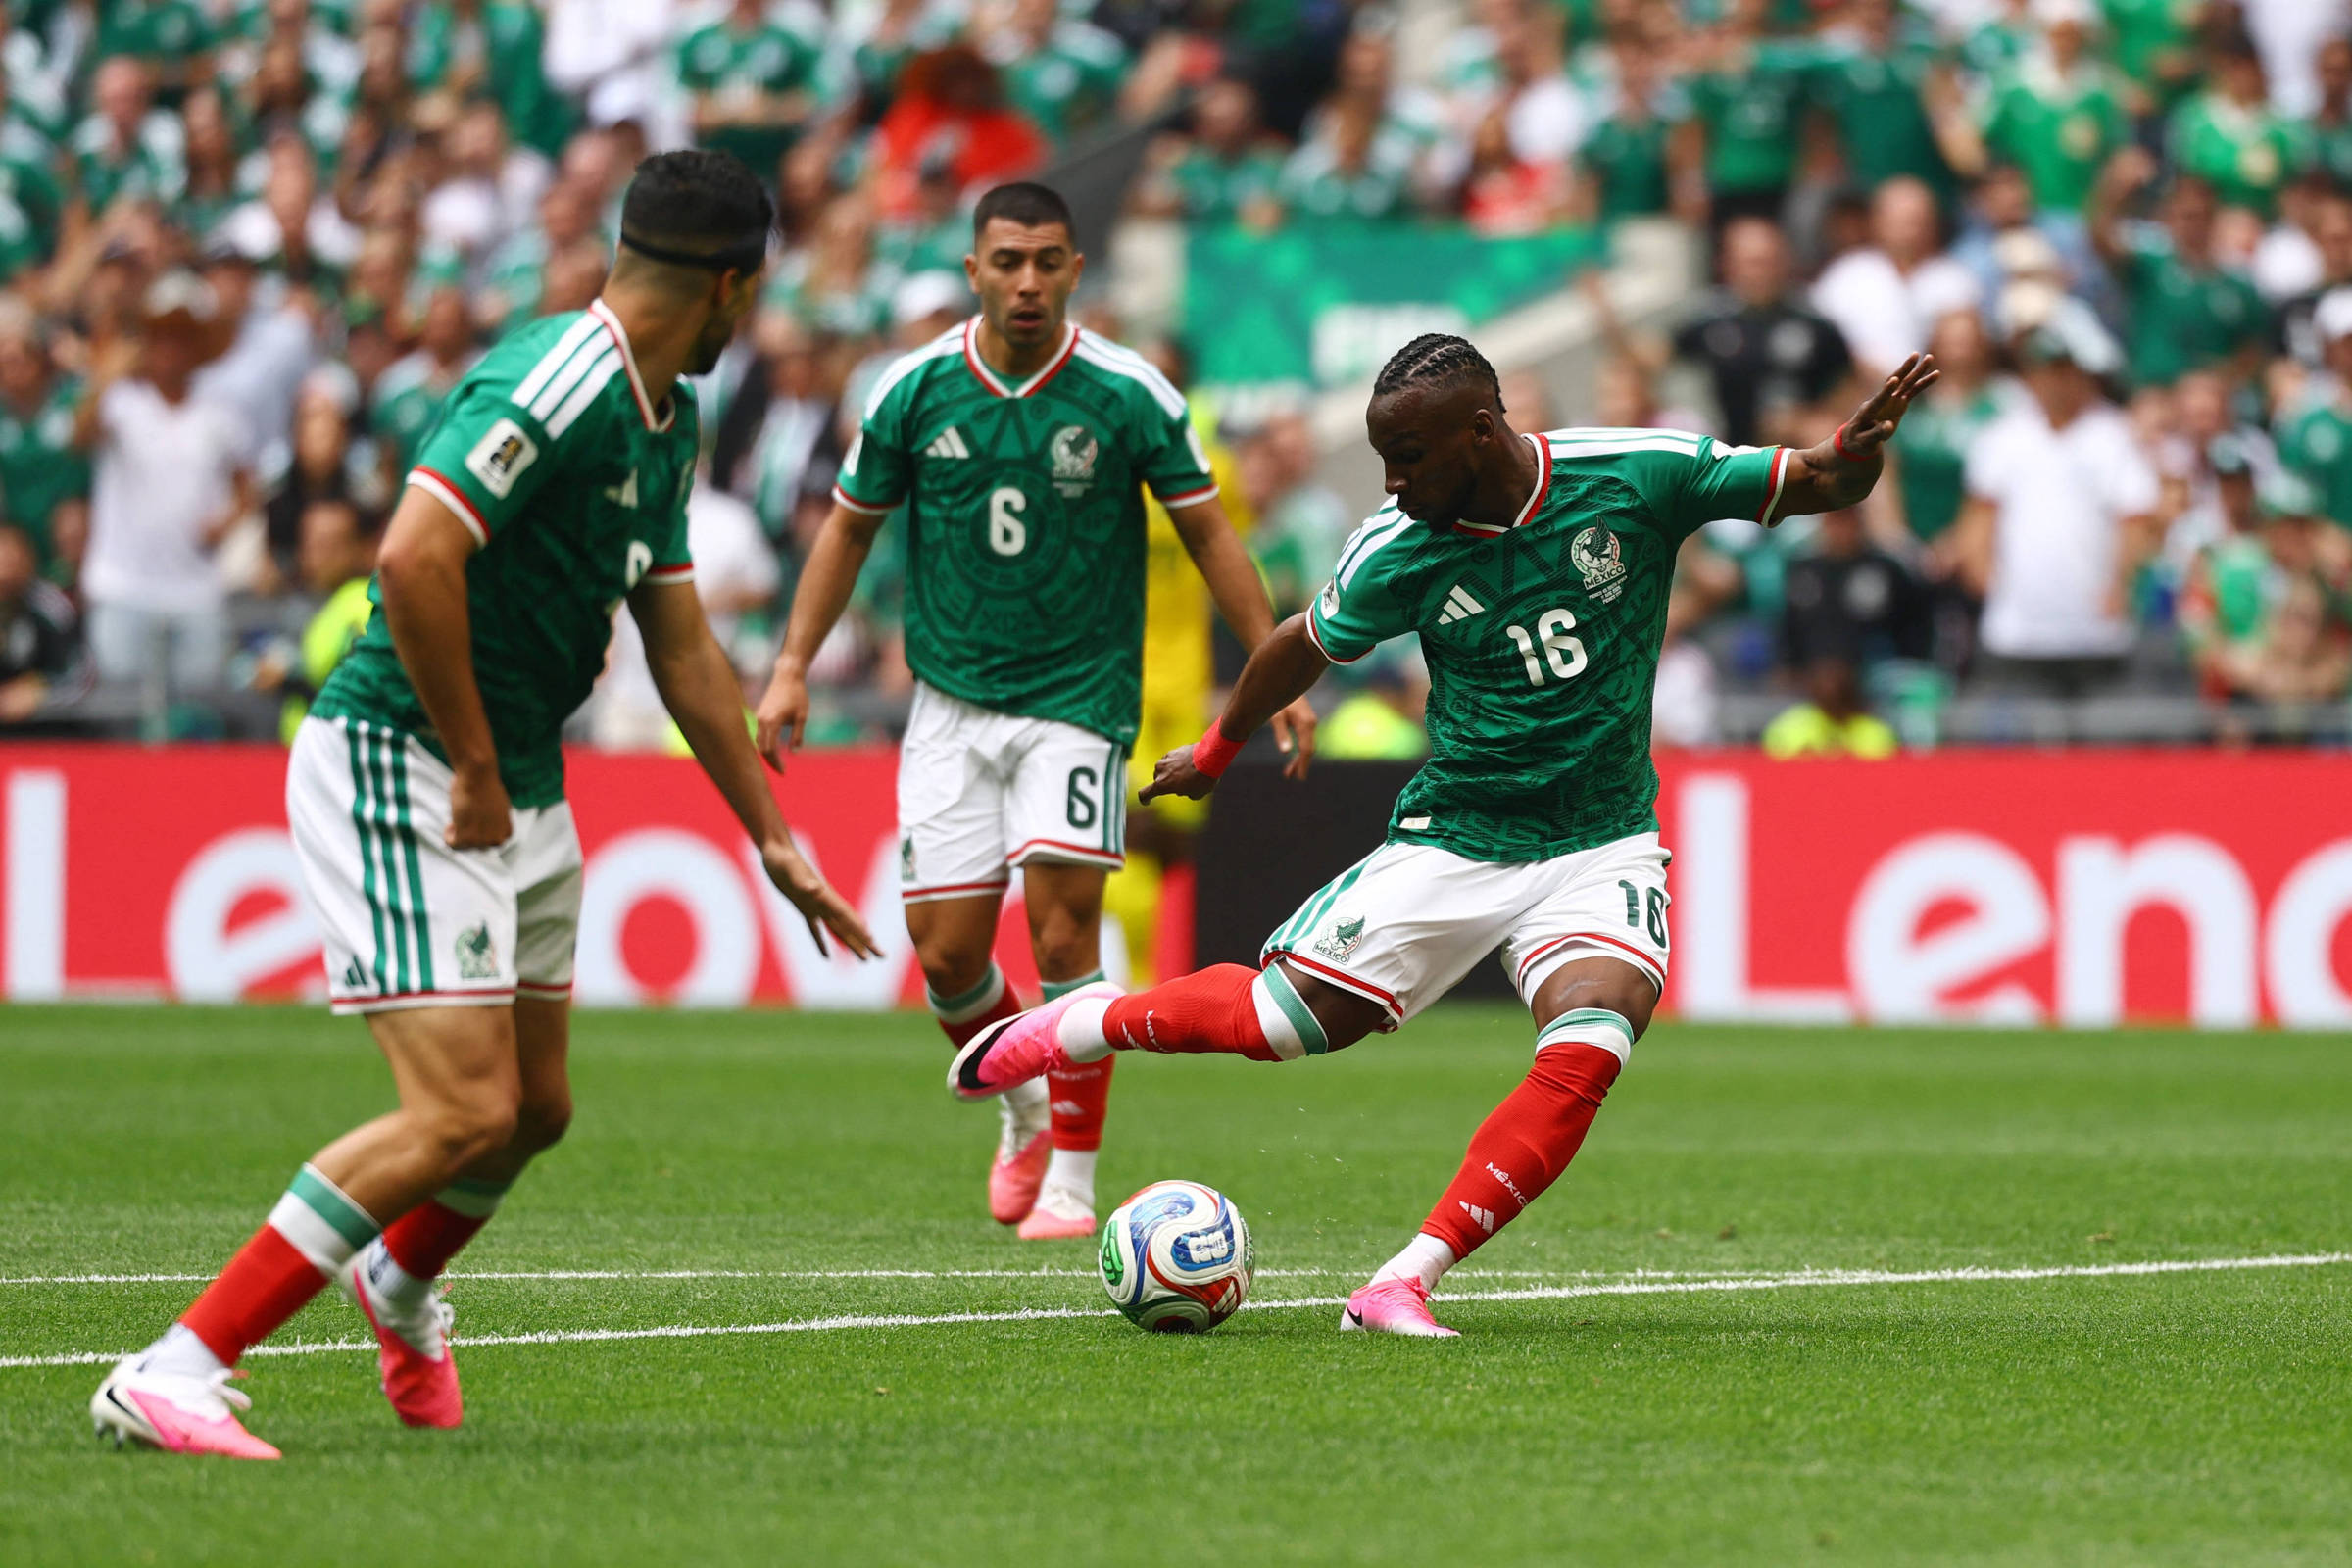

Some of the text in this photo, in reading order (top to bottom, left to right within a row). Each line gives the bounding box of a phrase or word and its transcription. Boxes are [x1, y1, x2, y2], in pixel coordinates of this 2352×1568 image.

[990, 487, 1026, 556] 6
[1585, 565, 1624, 588] MÉXICO
[1506, 609, 1588, 686] 16
[1067, 766, 1097, 829] 6
[10, 767, 1133, 1008] Leov
[1618, 879, 1666, 949] 16
[1485, 1161, 1528, 1208] MÉXIC
